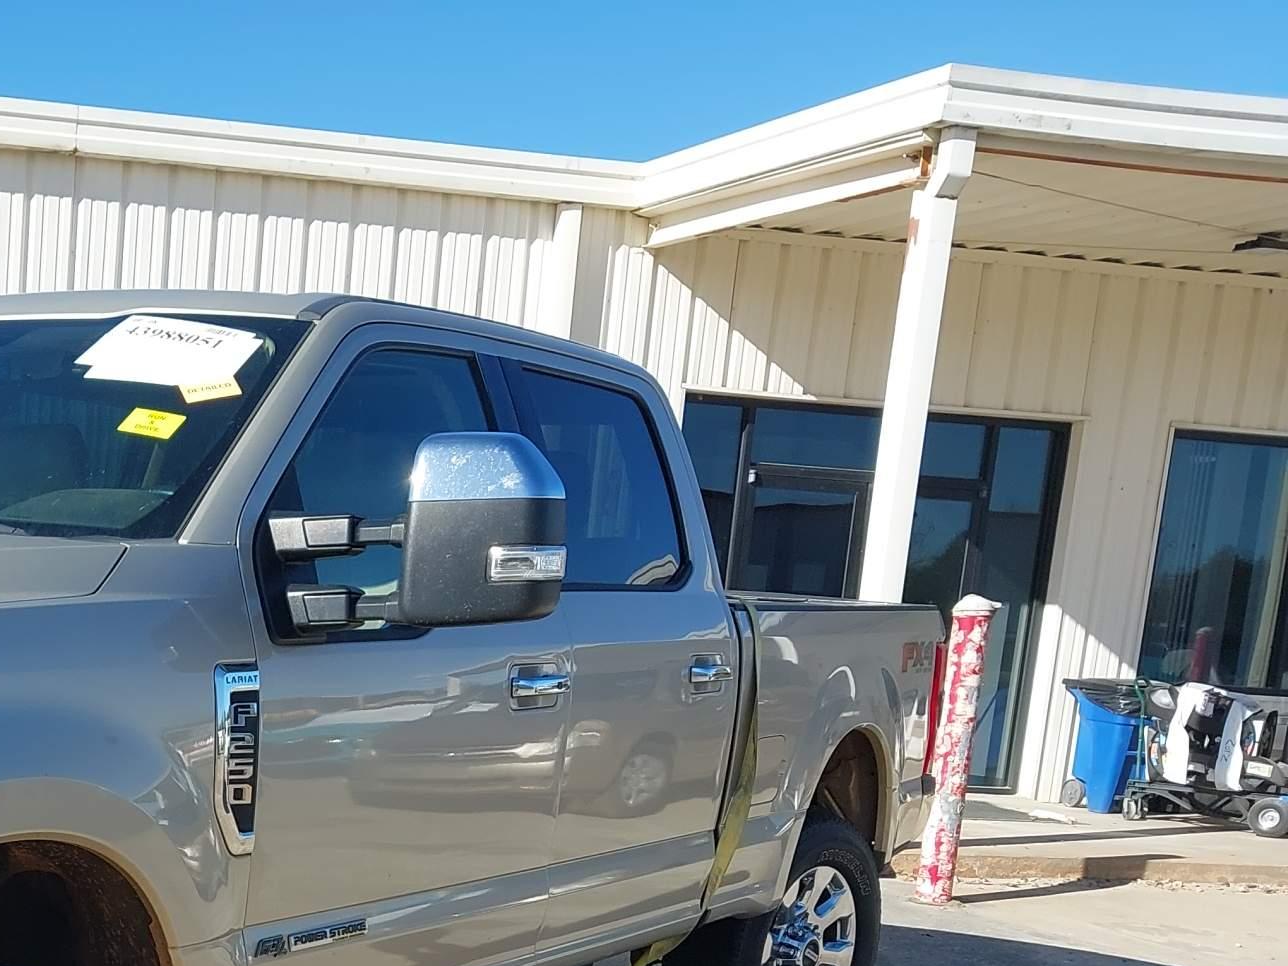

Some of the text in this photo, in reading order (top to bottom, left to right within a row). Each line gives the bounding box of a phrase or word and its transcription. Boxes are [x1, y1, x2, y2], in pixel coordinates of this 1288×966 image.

[225, 675, 259, 684] LARIAT
[228, 702, 258, 805] F250
[293, 930, 328, 946] POWER
[328, 921, 367, 939] STROKE
